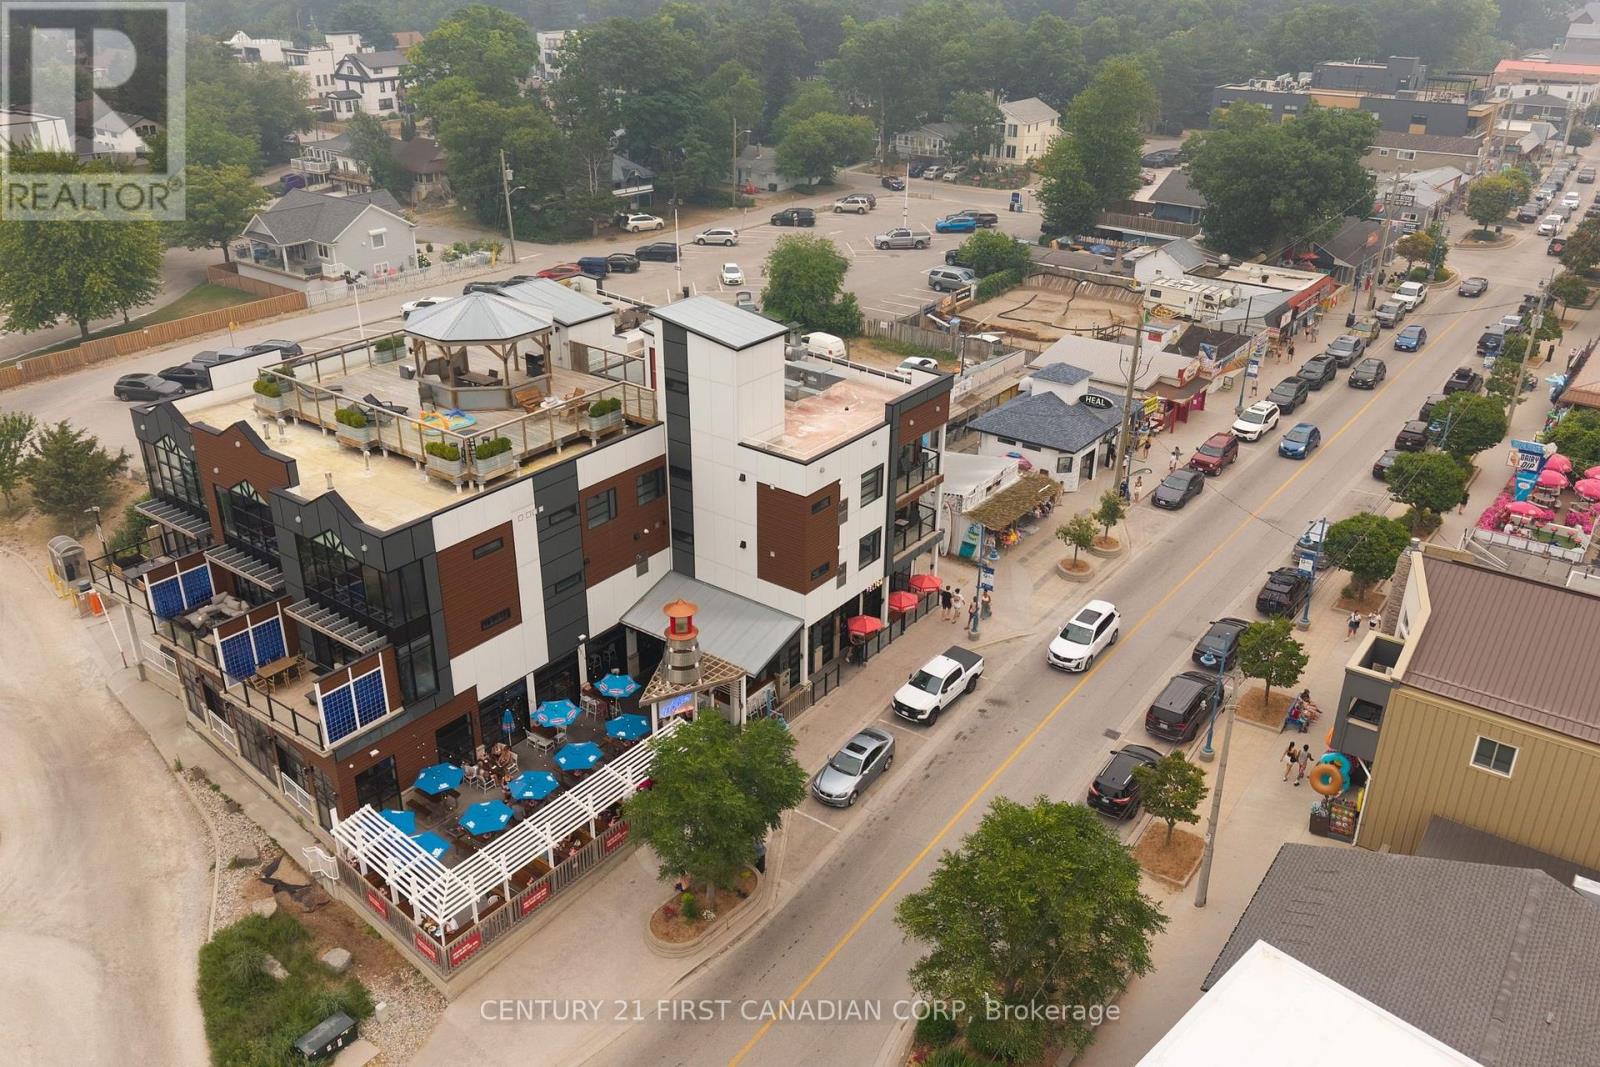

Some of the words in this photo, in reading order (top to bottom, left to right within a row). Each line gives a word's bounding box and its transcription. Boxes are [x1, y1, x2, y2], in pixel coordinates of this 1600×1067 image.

[1085, 395, 1105, 406] HEAL
[1520, 454, 1541, 464] DAIRY
[1520, 461, 1535, 469] DIP
